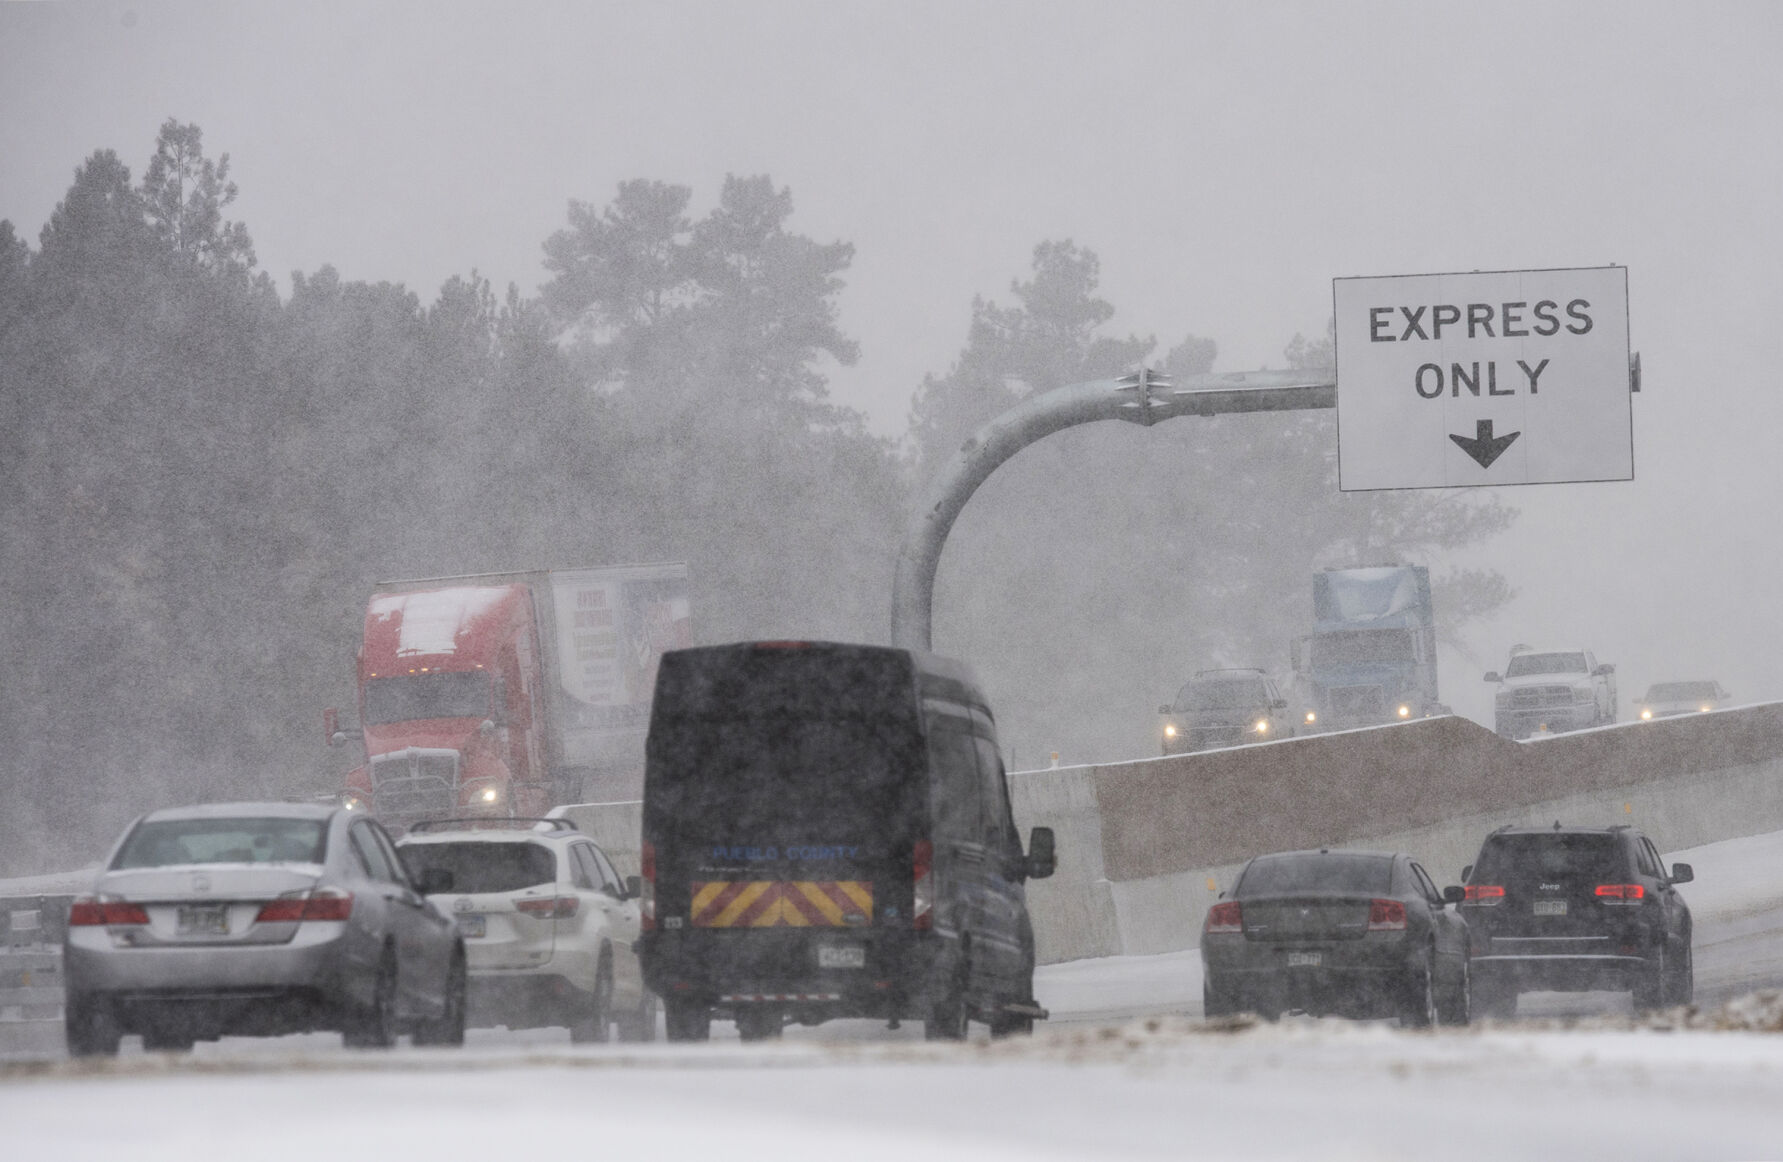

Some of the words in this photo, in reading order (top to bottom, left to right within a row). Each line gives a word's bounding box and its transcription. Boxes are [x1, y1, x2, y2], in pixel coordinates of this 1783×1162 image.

[1369, 298, 1594, 343] EXPRESS
[1415, 358, 1550, 399] ONLY
[713, 845, 779, 860] PUEBLO
[786, 845, 859, 860] COUNTY
[1539, 882, 1561, 891] Jeep
